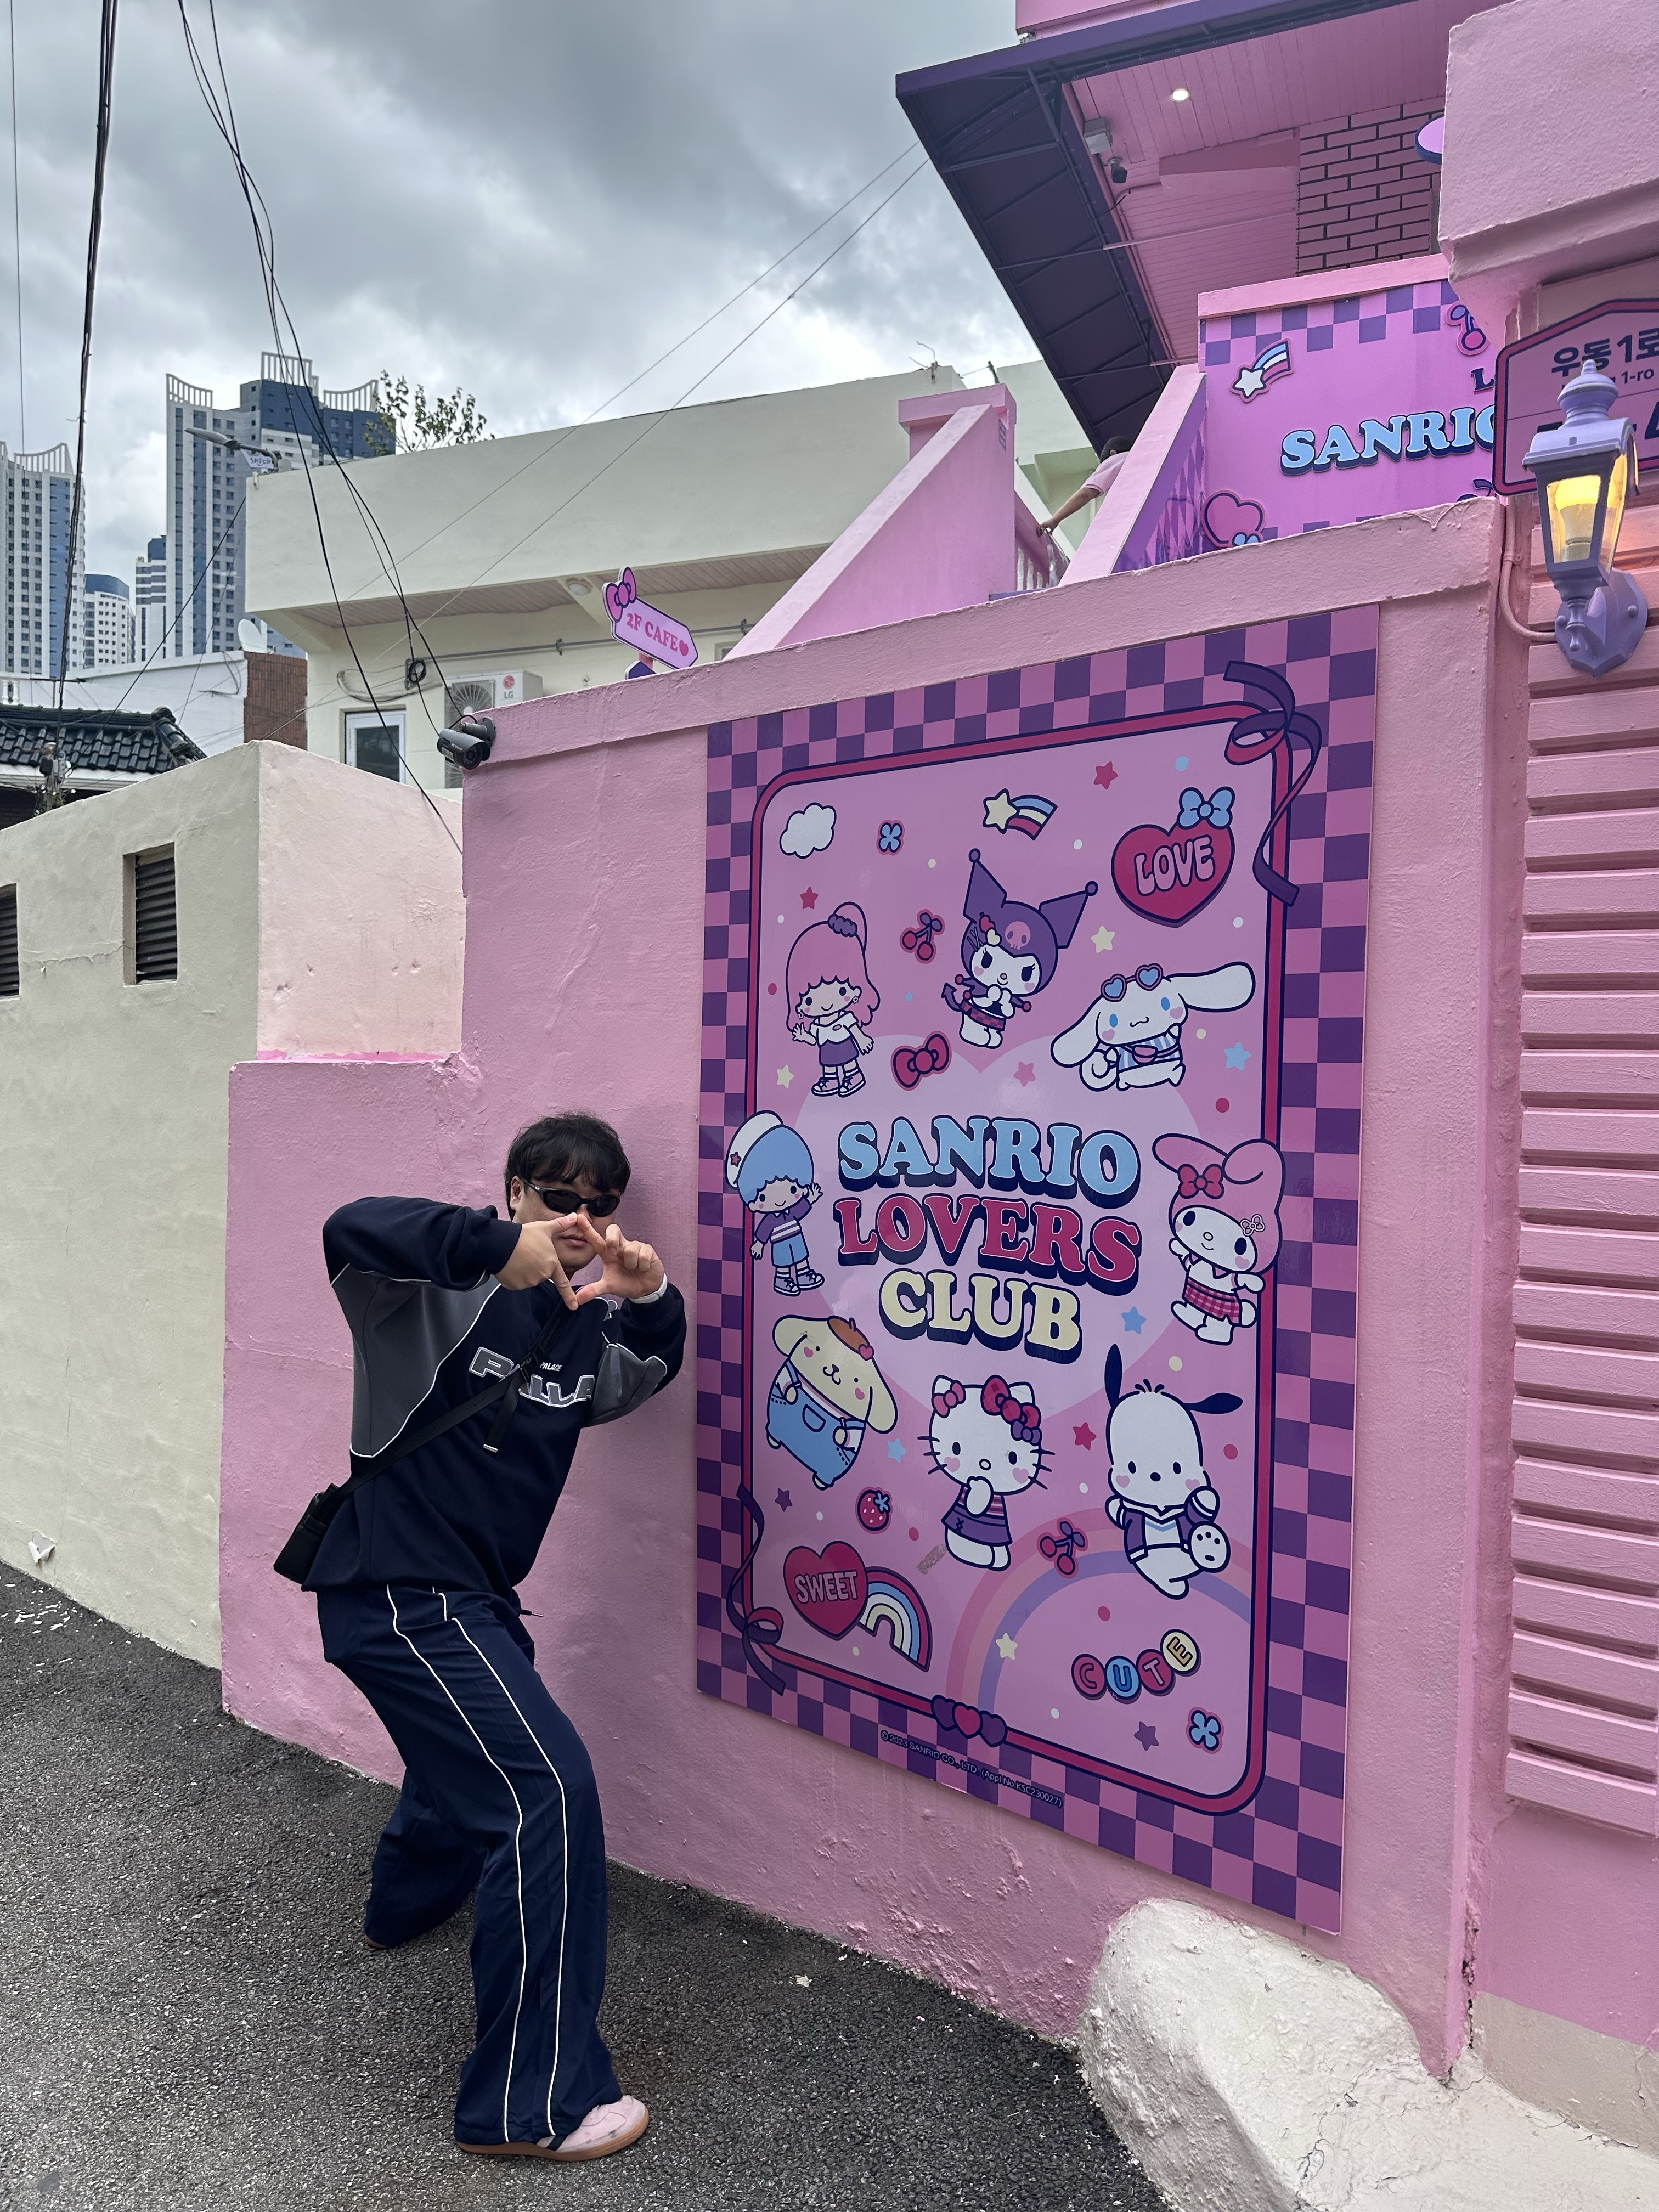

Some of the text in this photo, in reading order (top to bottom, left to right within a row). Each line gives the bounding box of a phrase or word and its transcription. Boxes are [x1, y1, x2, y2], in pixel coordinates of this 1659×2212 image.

[1621, 368, 1655, 385] 1-ro
[627, 613, 678, 652] 2F CAFE
[504, 691, 514, 699] LG
[1134, 834, 1216, 897] LOVE
[838, 1115, 1140, 1209] SANRIO
[833, 1193, 1142, 1296] LOVERS
[878, 1268, 1082, 1364] CLUB
[539, 1361, 563, 1372] PALACE
[793, 1569, 859, 1605] SWEET
[1077, 1634, 1194, 1694] CUTE
[889, 1735, 908, 1748] 2023
[909, 1742, 940, 1759] SANRIO
[941, 1754, 960, 1768] CO.,
[961, 1760, 980, 1775] LTD.
